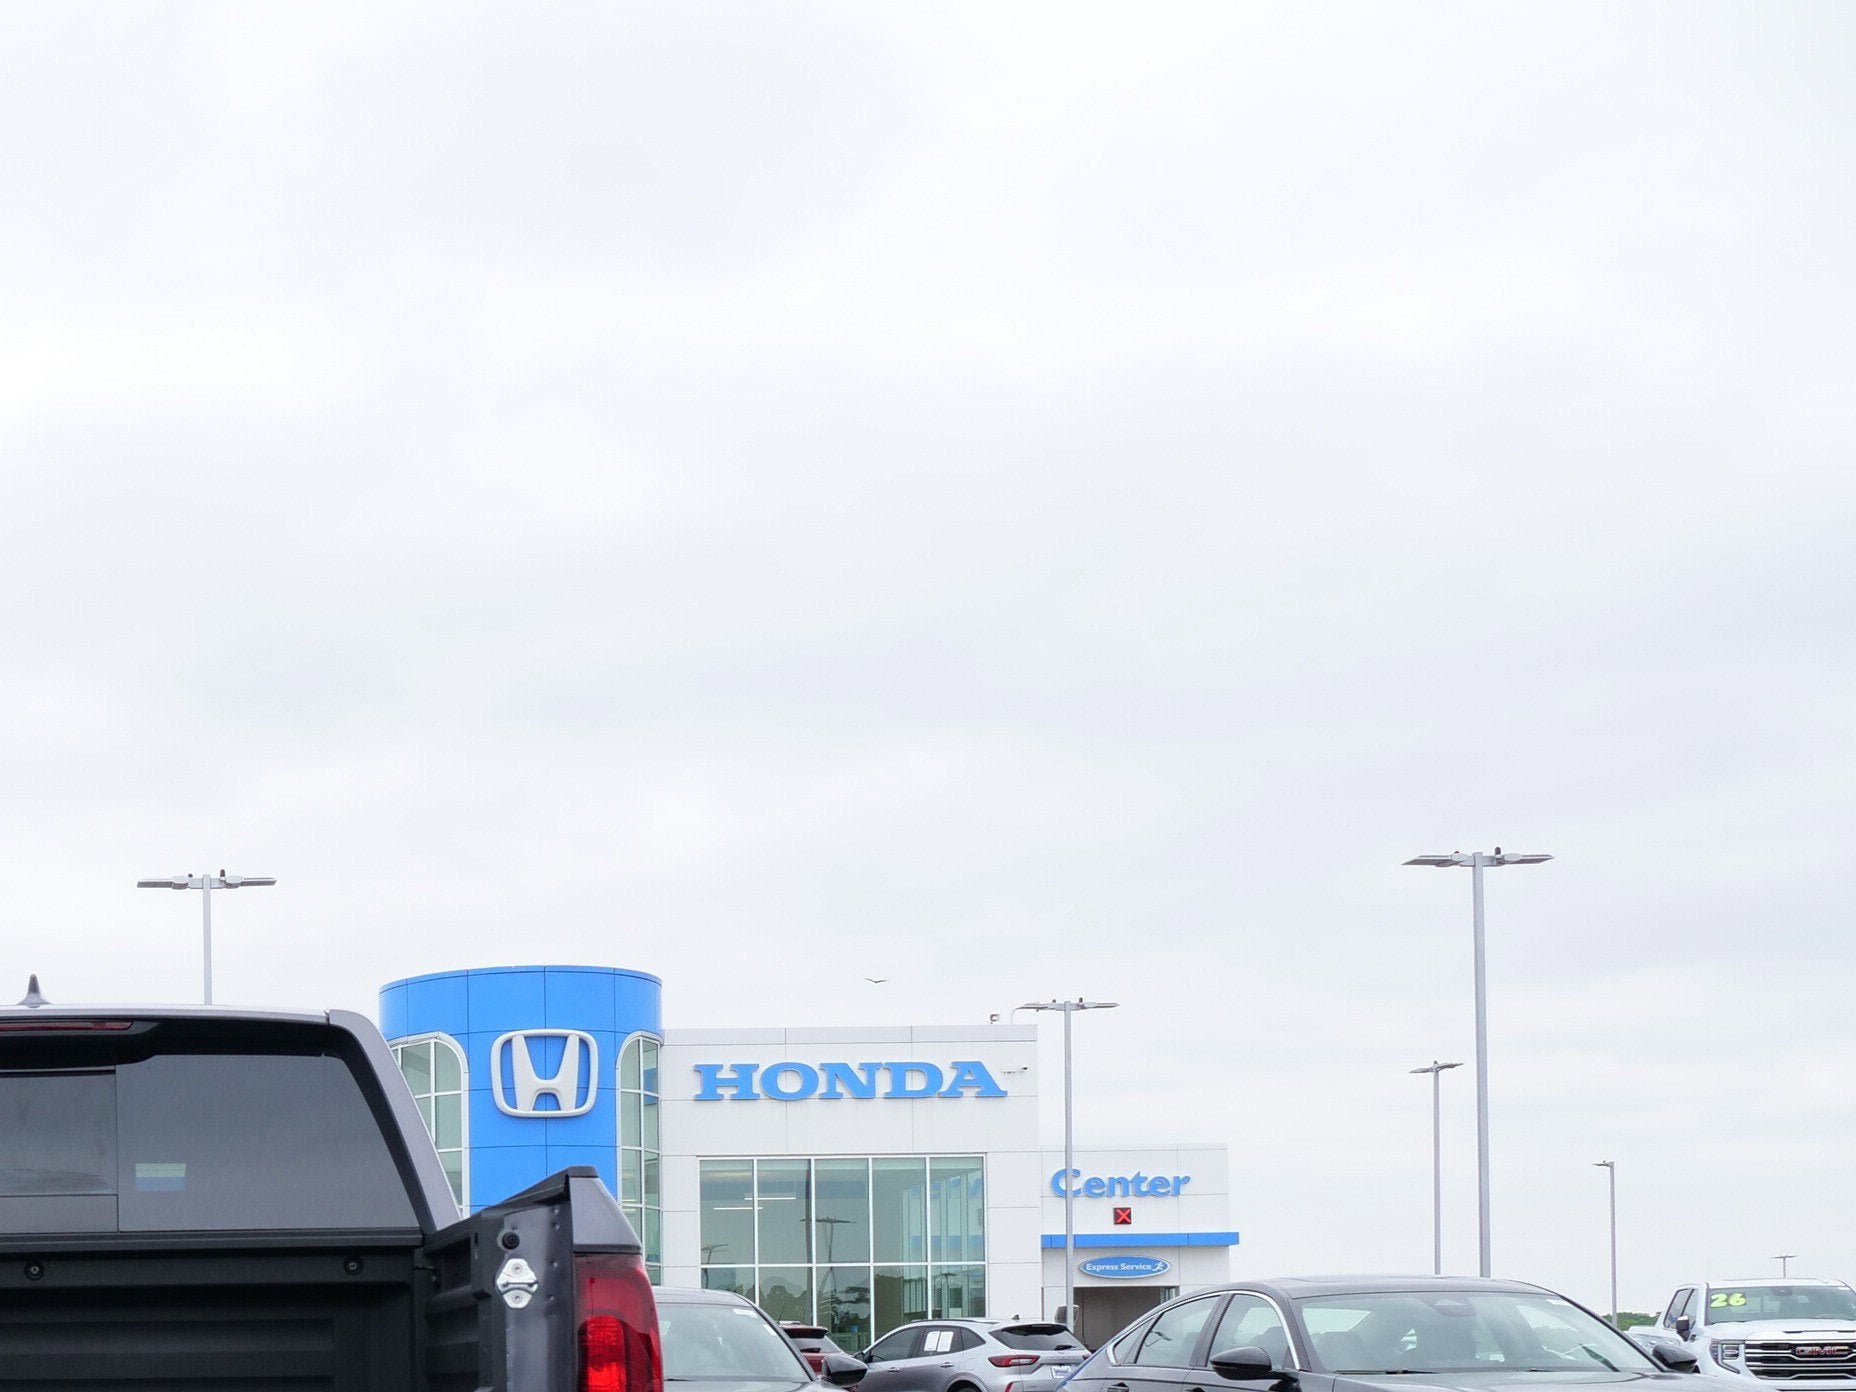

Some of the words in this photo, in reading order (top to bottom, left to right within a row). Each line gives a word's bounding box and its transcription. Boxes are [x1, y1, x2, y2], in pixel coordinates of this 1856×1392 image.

[693, 1060, 1008, 1101] HONDA
[1050, 1168, 1191, 1198] Center
[1086, 1262, 1119, 1273] Express
[1120, 1262, 1152, 1271] Service
[1710, 1292, 1747, 1308] 26
[1795, 1345, 1851, 1356] GMC
